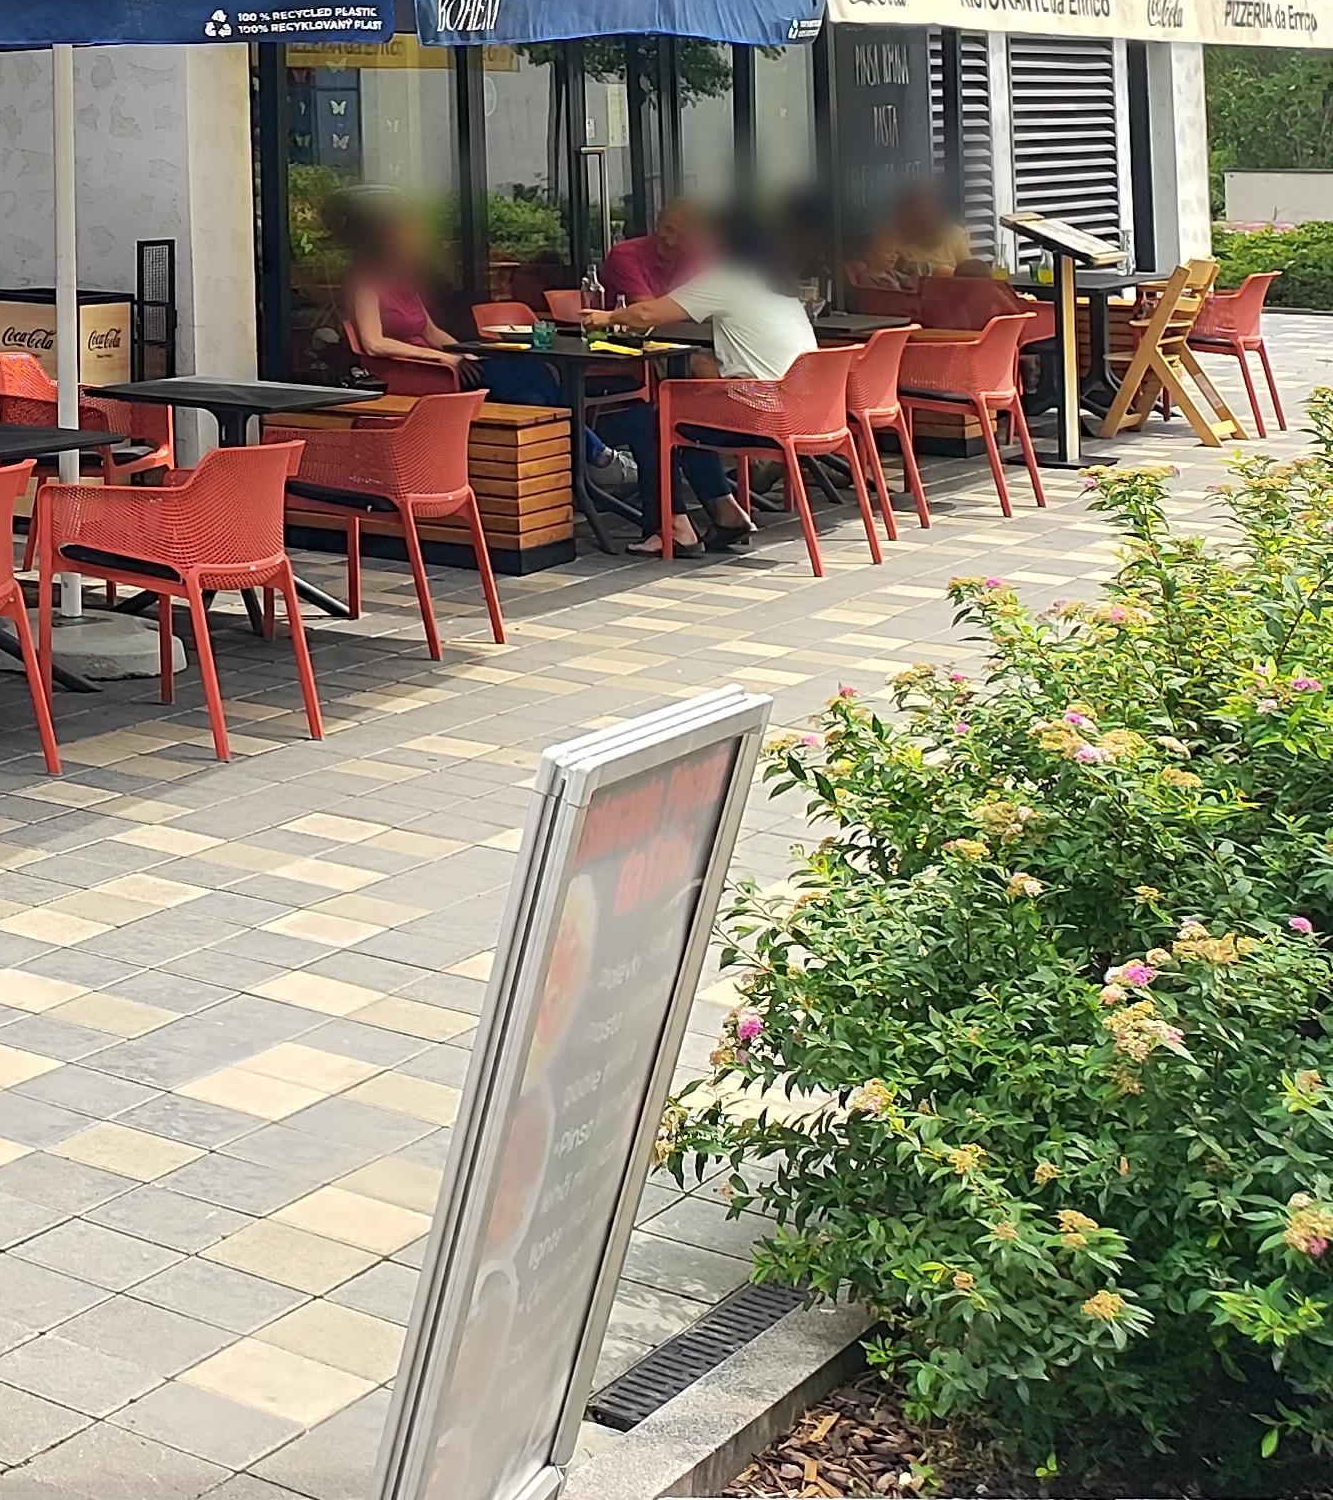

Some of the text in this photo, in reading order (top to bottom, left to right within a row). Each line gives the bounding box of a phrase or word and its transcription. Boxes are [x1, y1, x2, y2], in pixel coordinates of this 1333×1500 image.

[237, 12, 257, 22] 100
[272, 7, 332, 21] RECYCLED
[334, 6, 377, 18] PLASTIC
[353, 19, 383, 32] PLAST
[1224, 0, 1274, 30] PIZZERIA
[1274, 3, 1287, 30] da
[873, 104, 900, 149] PASTA
